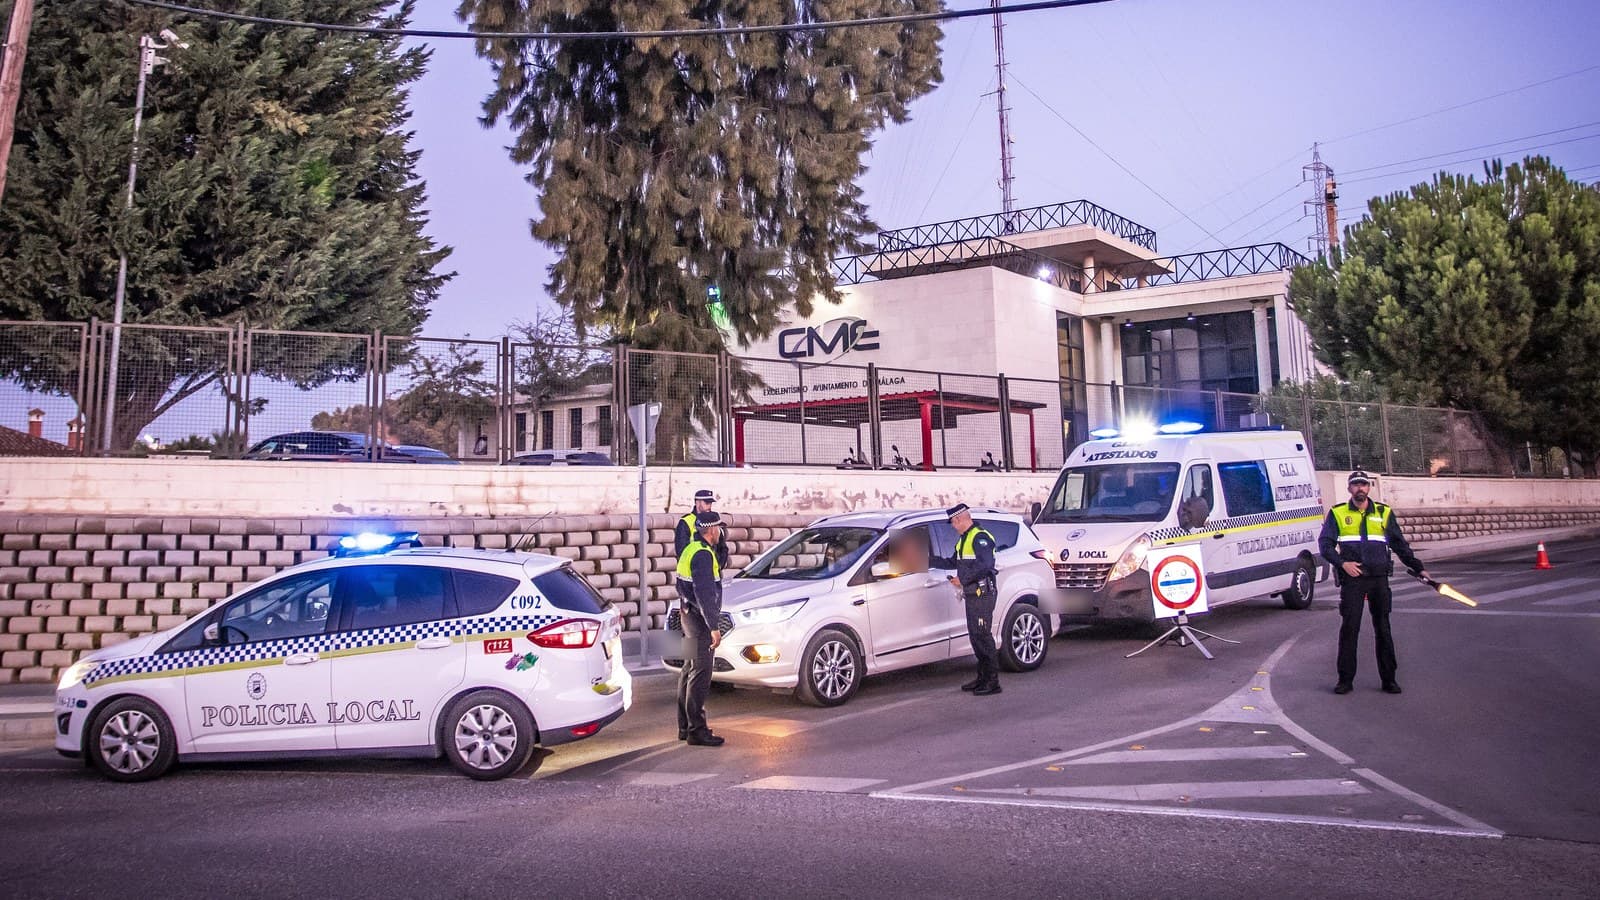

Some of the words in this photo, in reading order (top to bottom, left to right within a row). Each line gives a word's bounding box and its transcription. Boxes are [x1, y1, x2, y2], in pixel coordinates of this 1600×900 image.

[778, 320, 880, 359] CME
[813, 381, 858, 392] AYUNTAMIENTO
[1085, 450, 1158, 463] ATESTADOS
[1275, 484, 1313, 502] ATESTADOS
[1078, 550, 1108, 560] LOCAL
[201, 702, 316, 727] POLICIA
[327, 699, 420, 724] LOCAL
